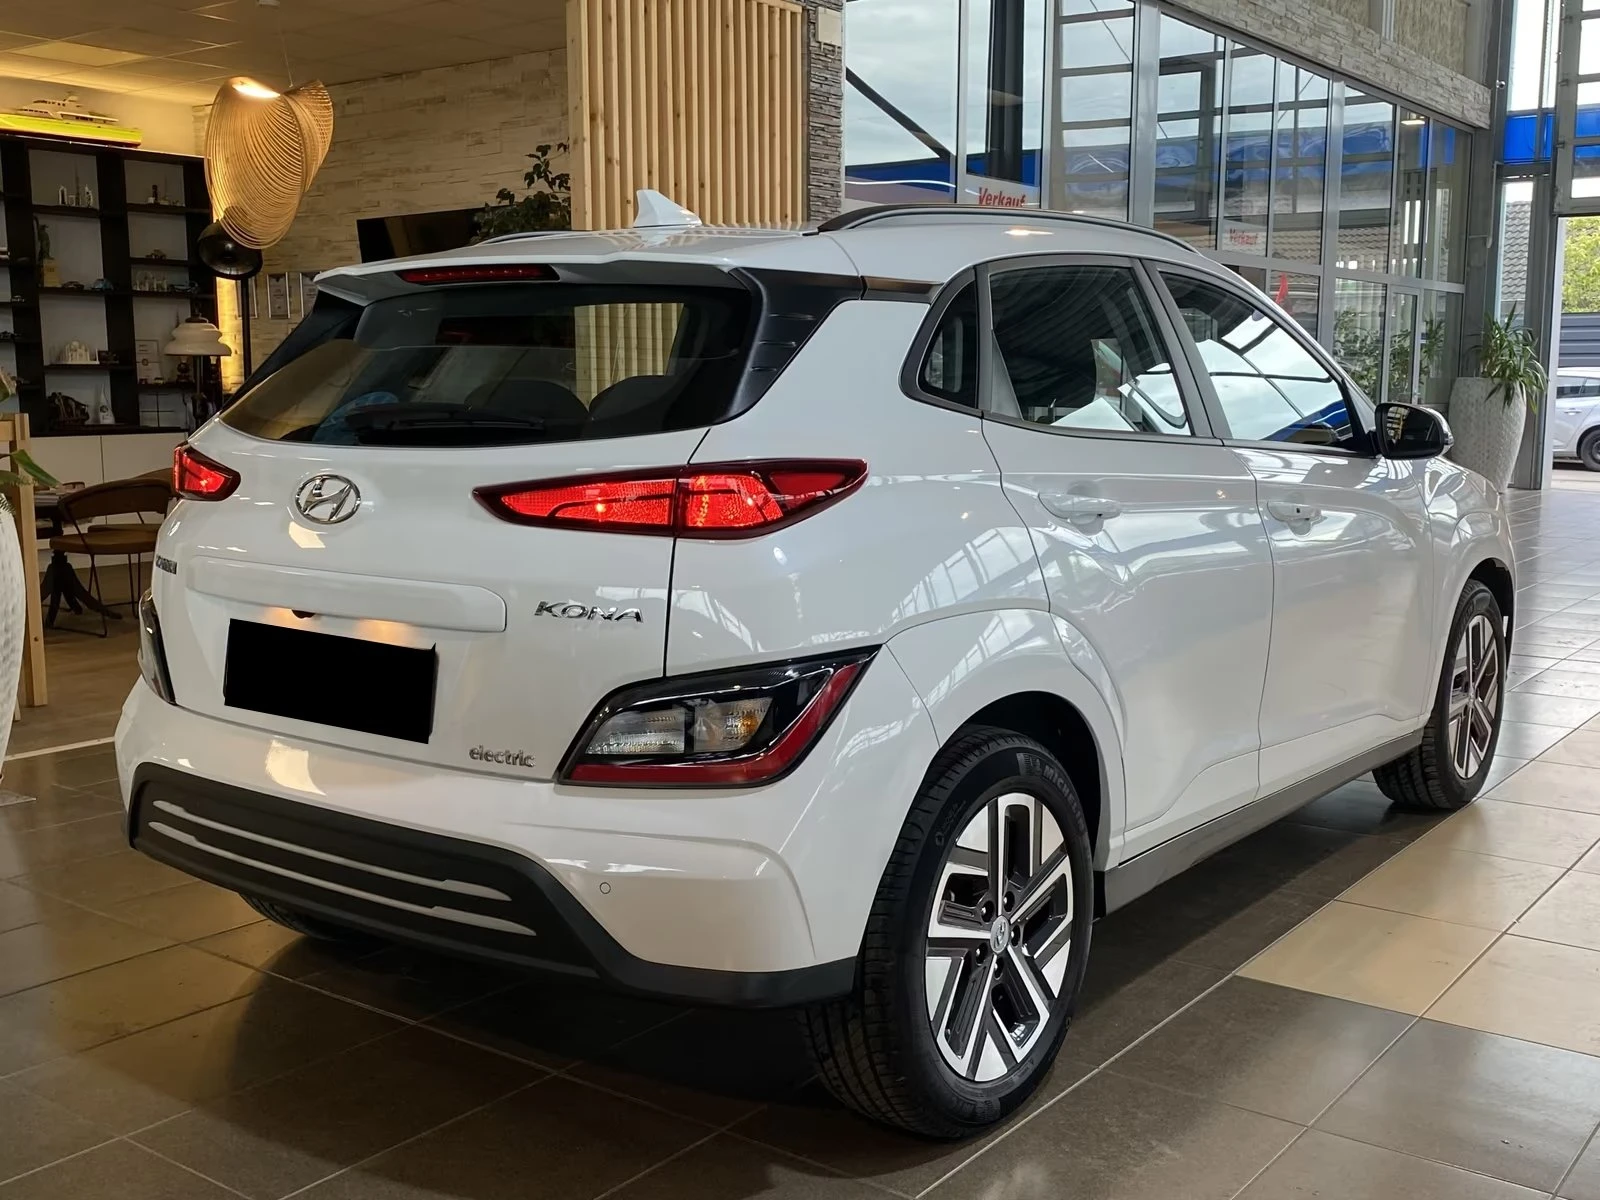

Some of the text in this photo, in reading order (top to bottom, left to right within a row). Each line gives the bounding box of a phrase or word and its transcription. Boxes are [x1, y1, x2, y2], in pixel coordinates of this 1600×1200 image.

[978, 187, 1026, 207] Verkauf
[534, 600, 643, 623] KONA
[469, 744, 536, 768] electric
[1043, 764, 1085, 834] MICHELIN
